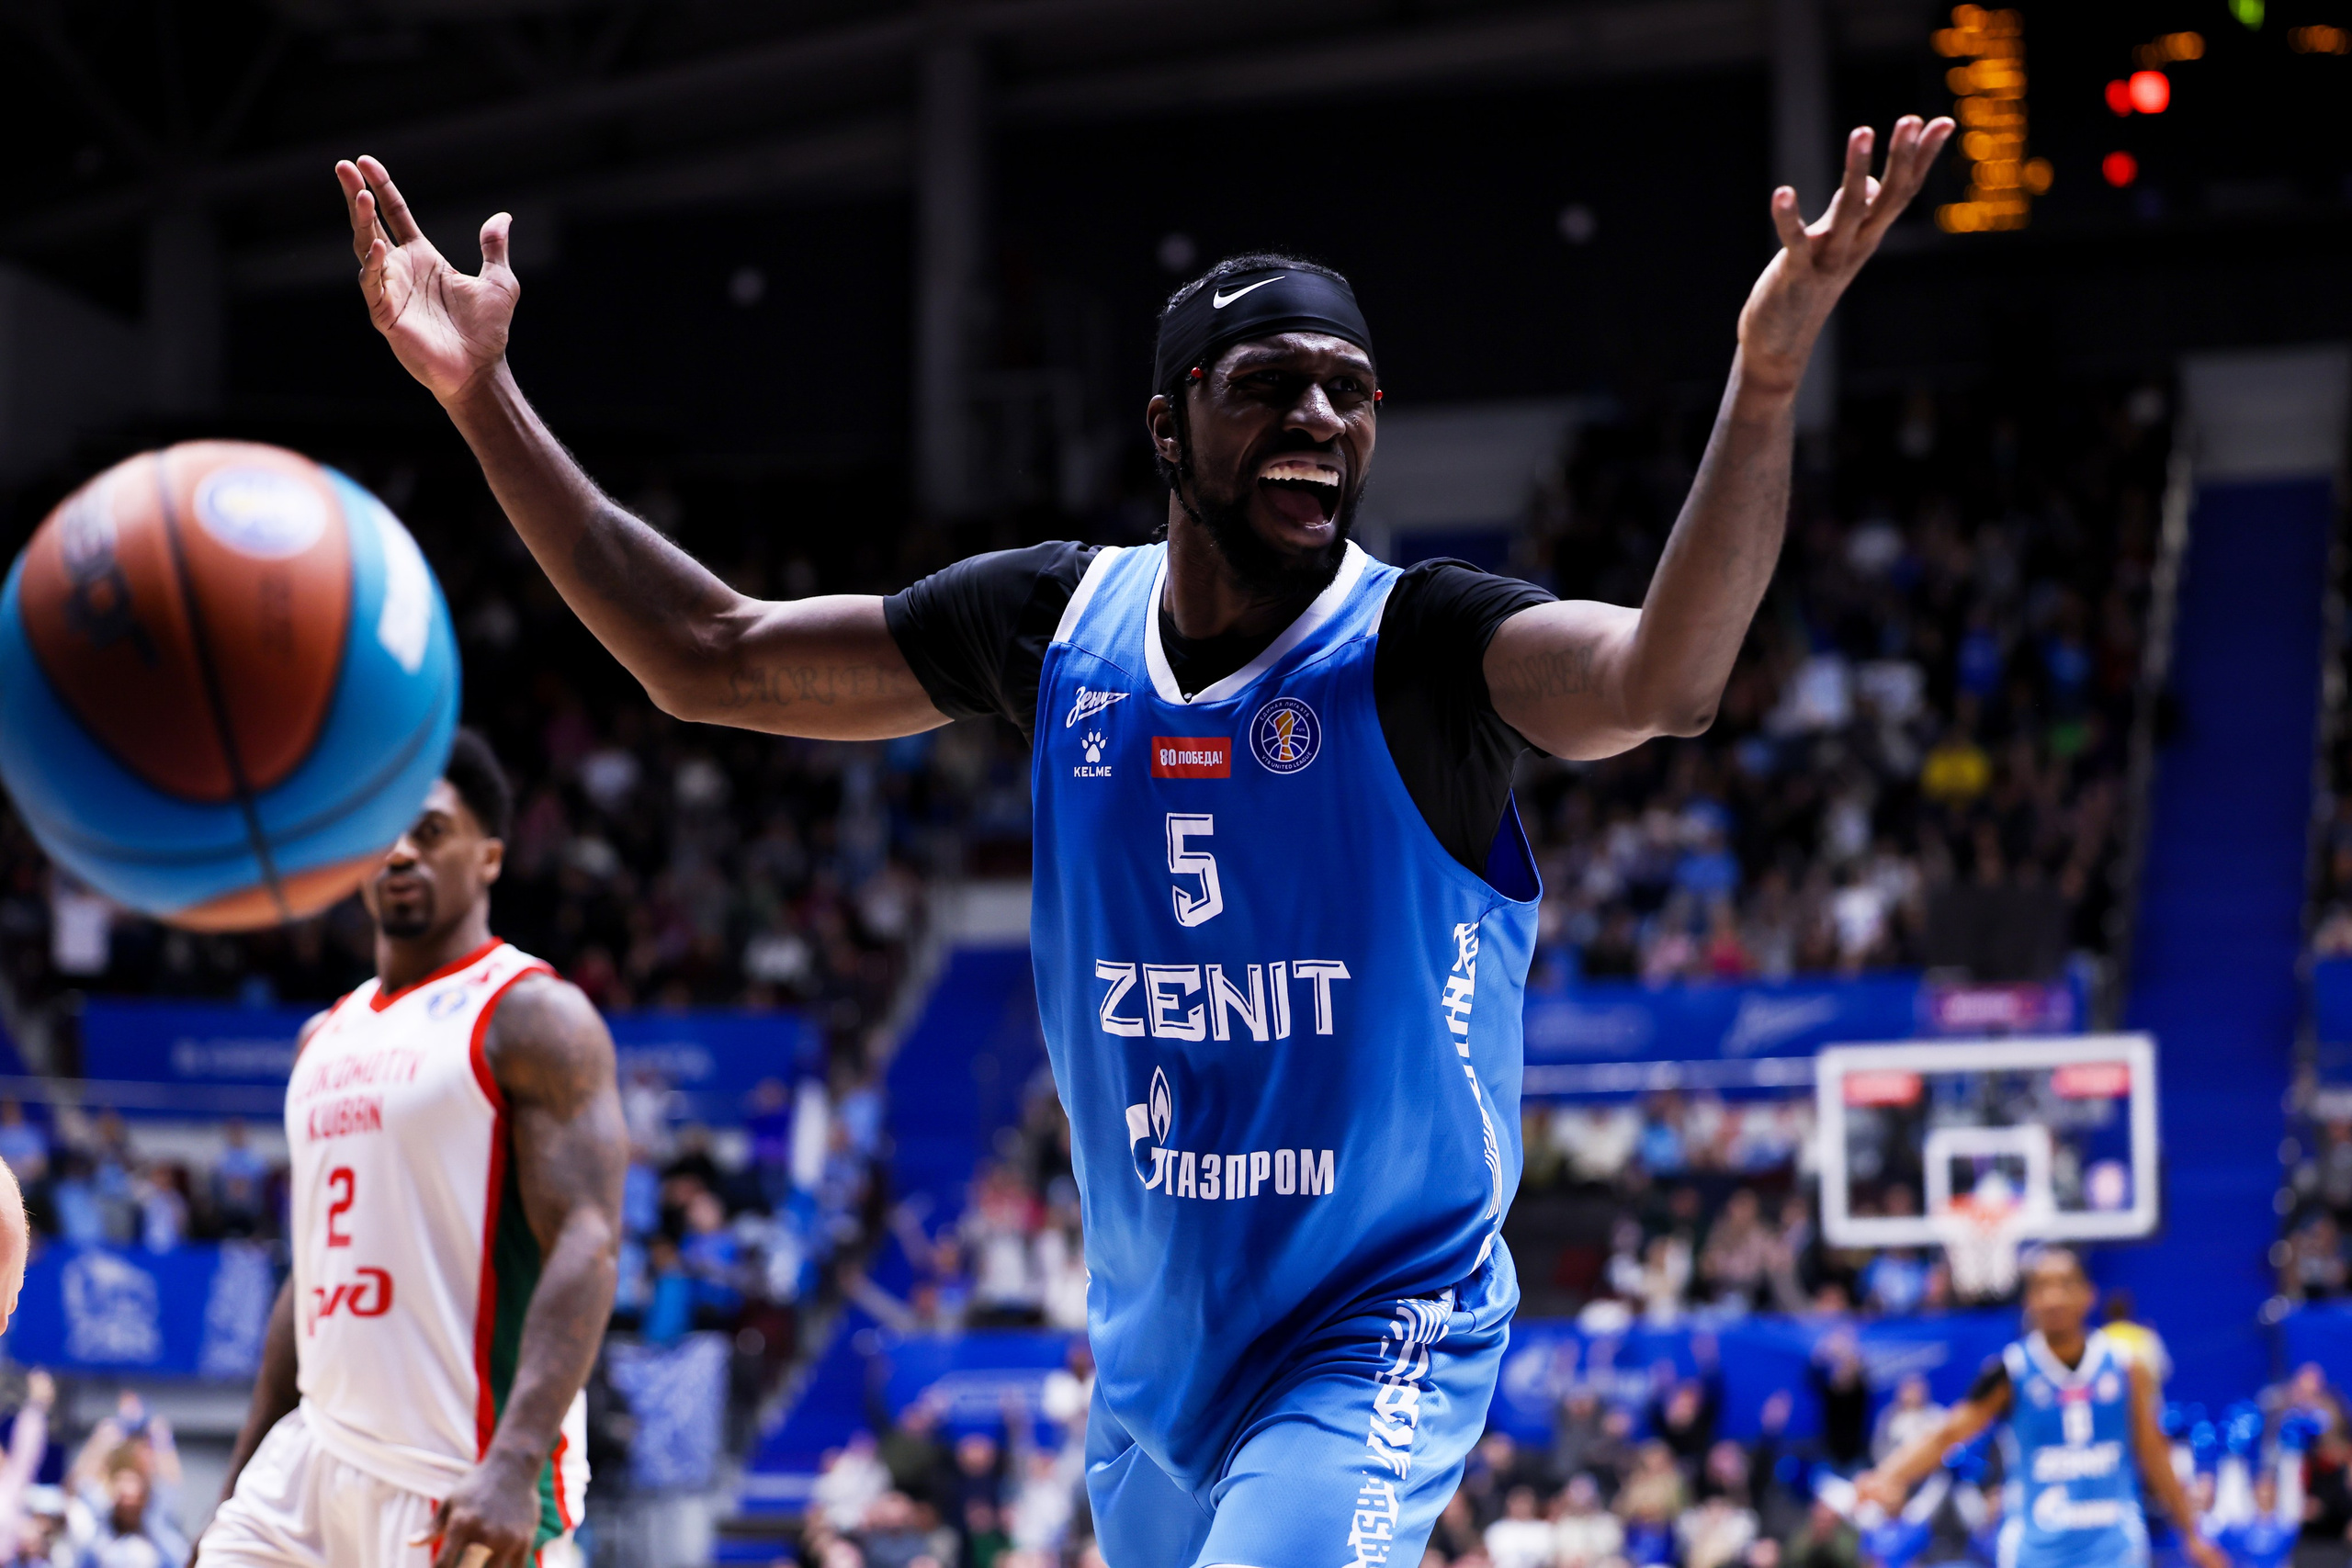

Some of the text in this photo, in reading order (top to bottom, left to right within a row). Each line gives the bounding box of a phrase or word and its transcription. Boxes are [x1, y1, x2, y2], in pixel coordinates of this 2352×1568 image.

[1260, 702, 1283, 721] ЕДИНАЯ
[1074, 766, 1112, 777] KELME
[1159, 749, 1223, 766] 80 ПОБЕДА!
[1261, 754, 1271, 765] VTB
[1293, 751, 1312, 768] LEAGUE
[1166, 812, 1223, 928] 5
[1095, 959, 1351, 1042] ZENIT
[1165, 1148, 1335, 1201] ГАЗПРОМ
[327, 1166, 356, 1249] 2
